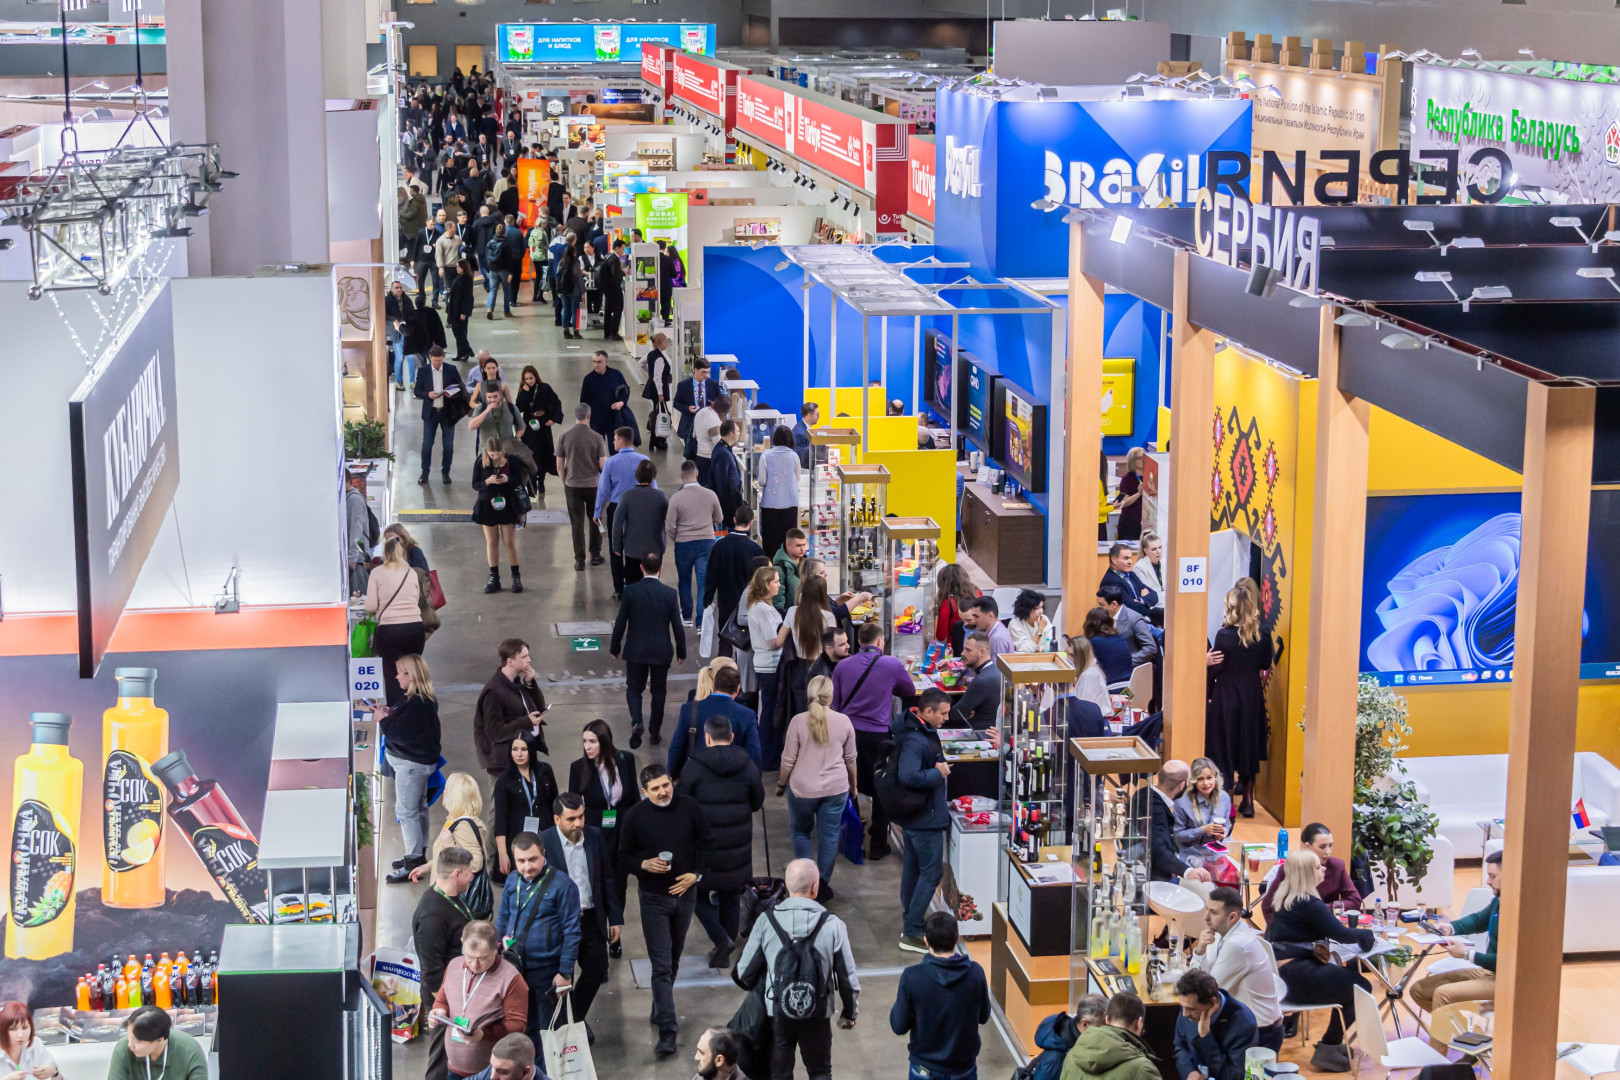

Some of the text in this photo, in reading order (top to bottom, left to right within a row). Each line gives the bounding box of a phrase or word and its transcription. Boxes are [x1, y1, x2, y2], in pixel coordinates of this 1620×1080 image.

[1254, 94, 1262, 106] The
[1263, 97, 1281, 109] National
[1281, 99, 1298, 112] Pavilion
[1311, 103, 1328, 116] Islamic
[1328, 105, 1349, 121] Republic
[1355, 110, 1365, 123] Iran
[1326, 123, 1352, 139] Республики
[1426, 98, 1504, 144] Республика
[1510, 109, 1580, 161] Беларусь
[911, 159, 936, 206] Türkiye
[1194, 187, 1321, 296] СЕРБИЯ
[103, 349, 166, 531] КУБАНОЧКА
[1182, 577, 1203, 586] 010
[1186, 564, 1200, 573] 8F
[358, 666, 375, 675] 8E
[354, 681, 380, 690] 020
[120, 779, 149, 803] СОК
[30, 829, 60, 856] СОК
[216, 840, 252, 873] СОК
